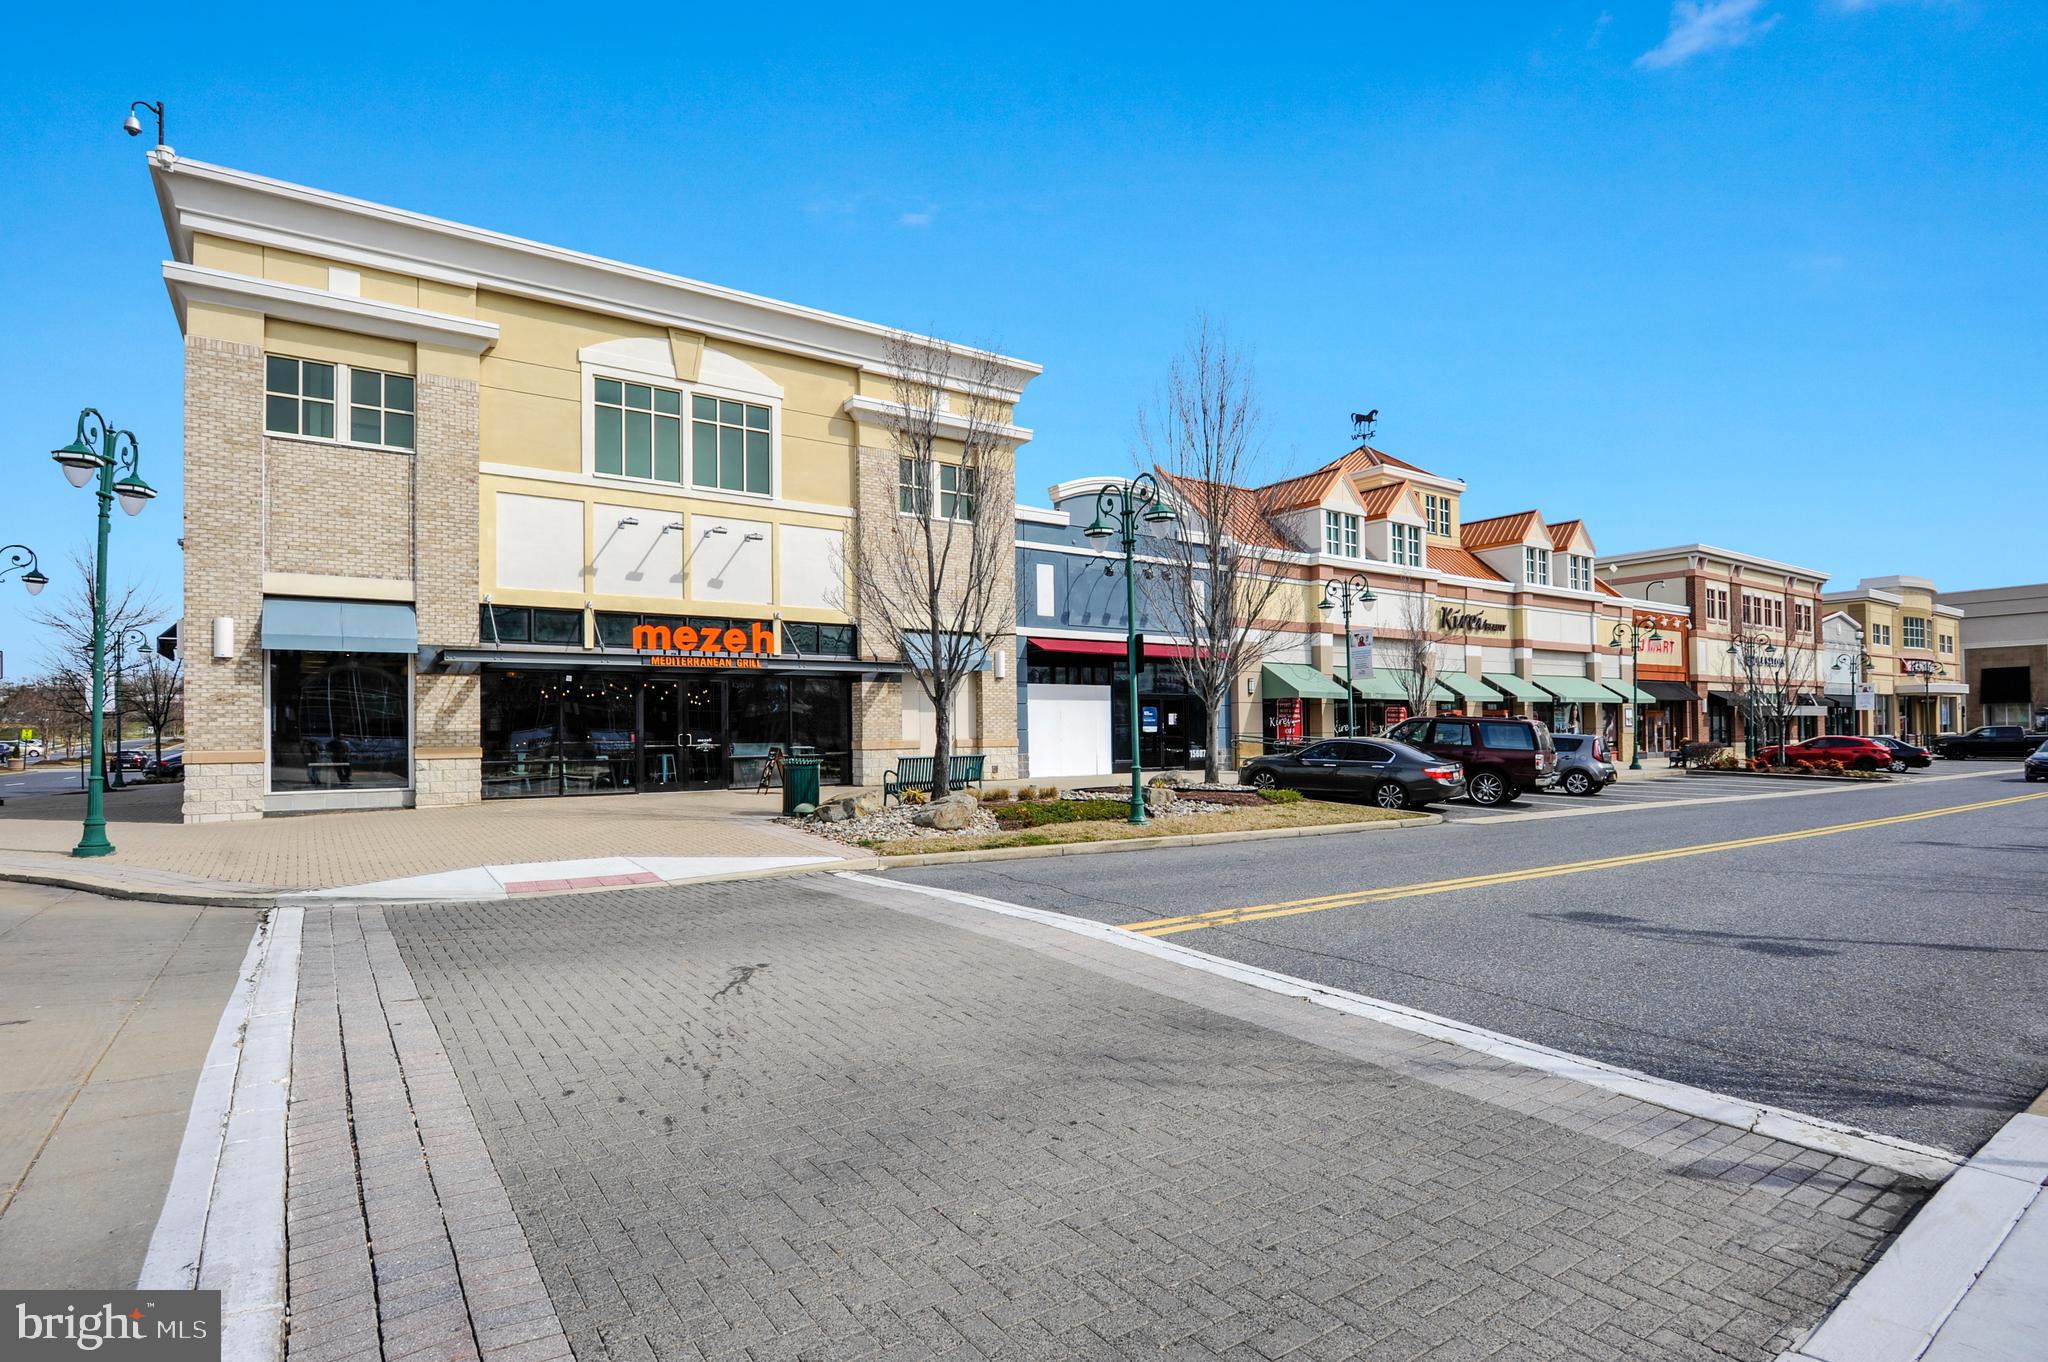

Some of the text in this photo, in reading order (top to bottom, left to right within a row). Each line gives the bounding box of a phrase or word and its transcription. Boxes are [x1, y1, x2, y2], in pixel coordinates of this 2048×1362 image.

[632, 622, 782, 654] mezeh
[651, 656, 761, 668] MEDITERRANEAN GRILL
